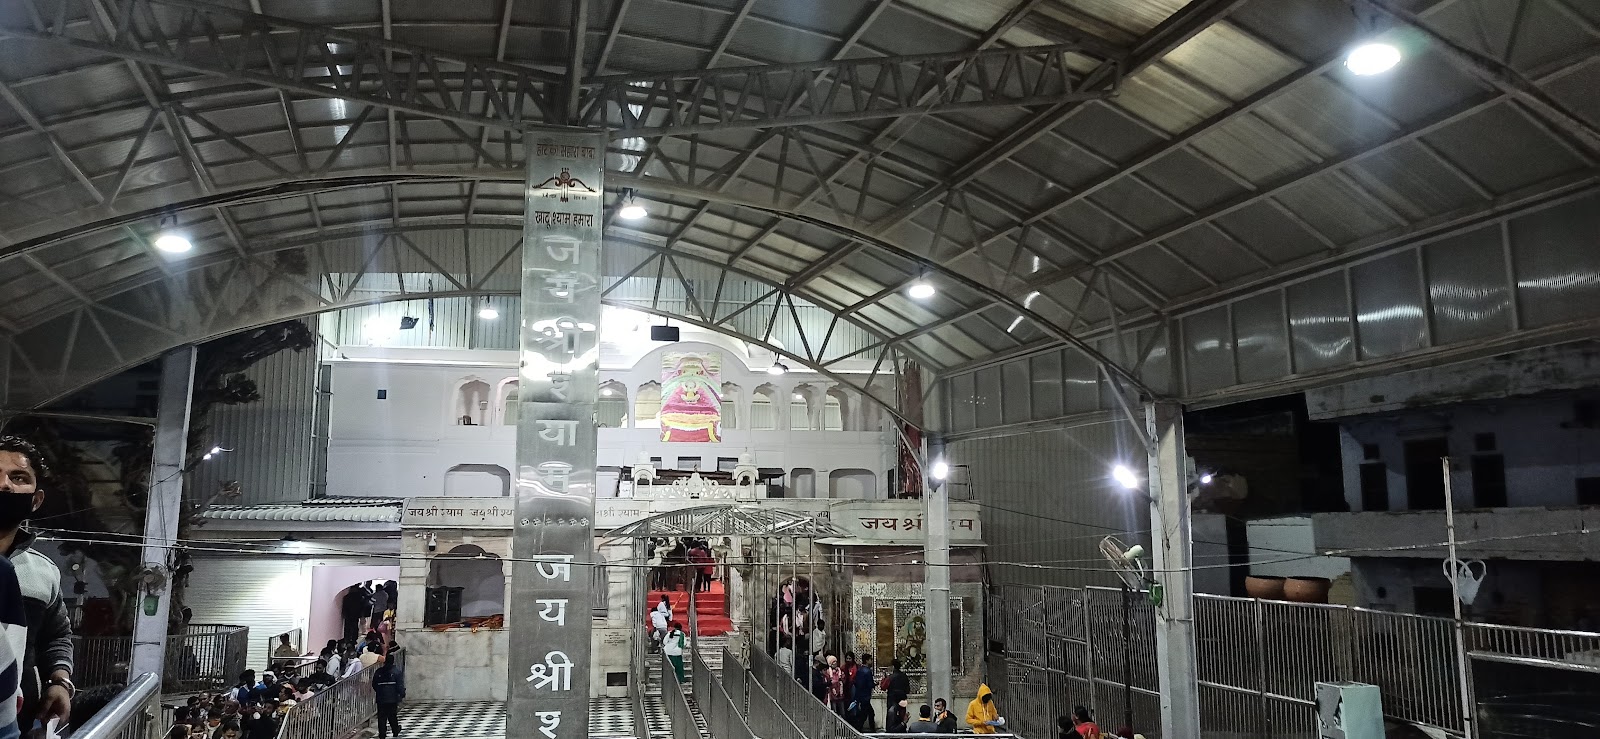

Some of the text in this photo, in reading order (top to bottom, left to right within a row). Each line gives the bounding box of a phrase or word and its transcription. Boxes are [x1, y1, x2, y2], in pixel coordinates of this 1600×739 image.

[573, 213, 593, 227] हमारा
[408, 508, 424, 517] जय
[426, 505, 438, 517] श्री
[859, 517, 898, 531] जय
